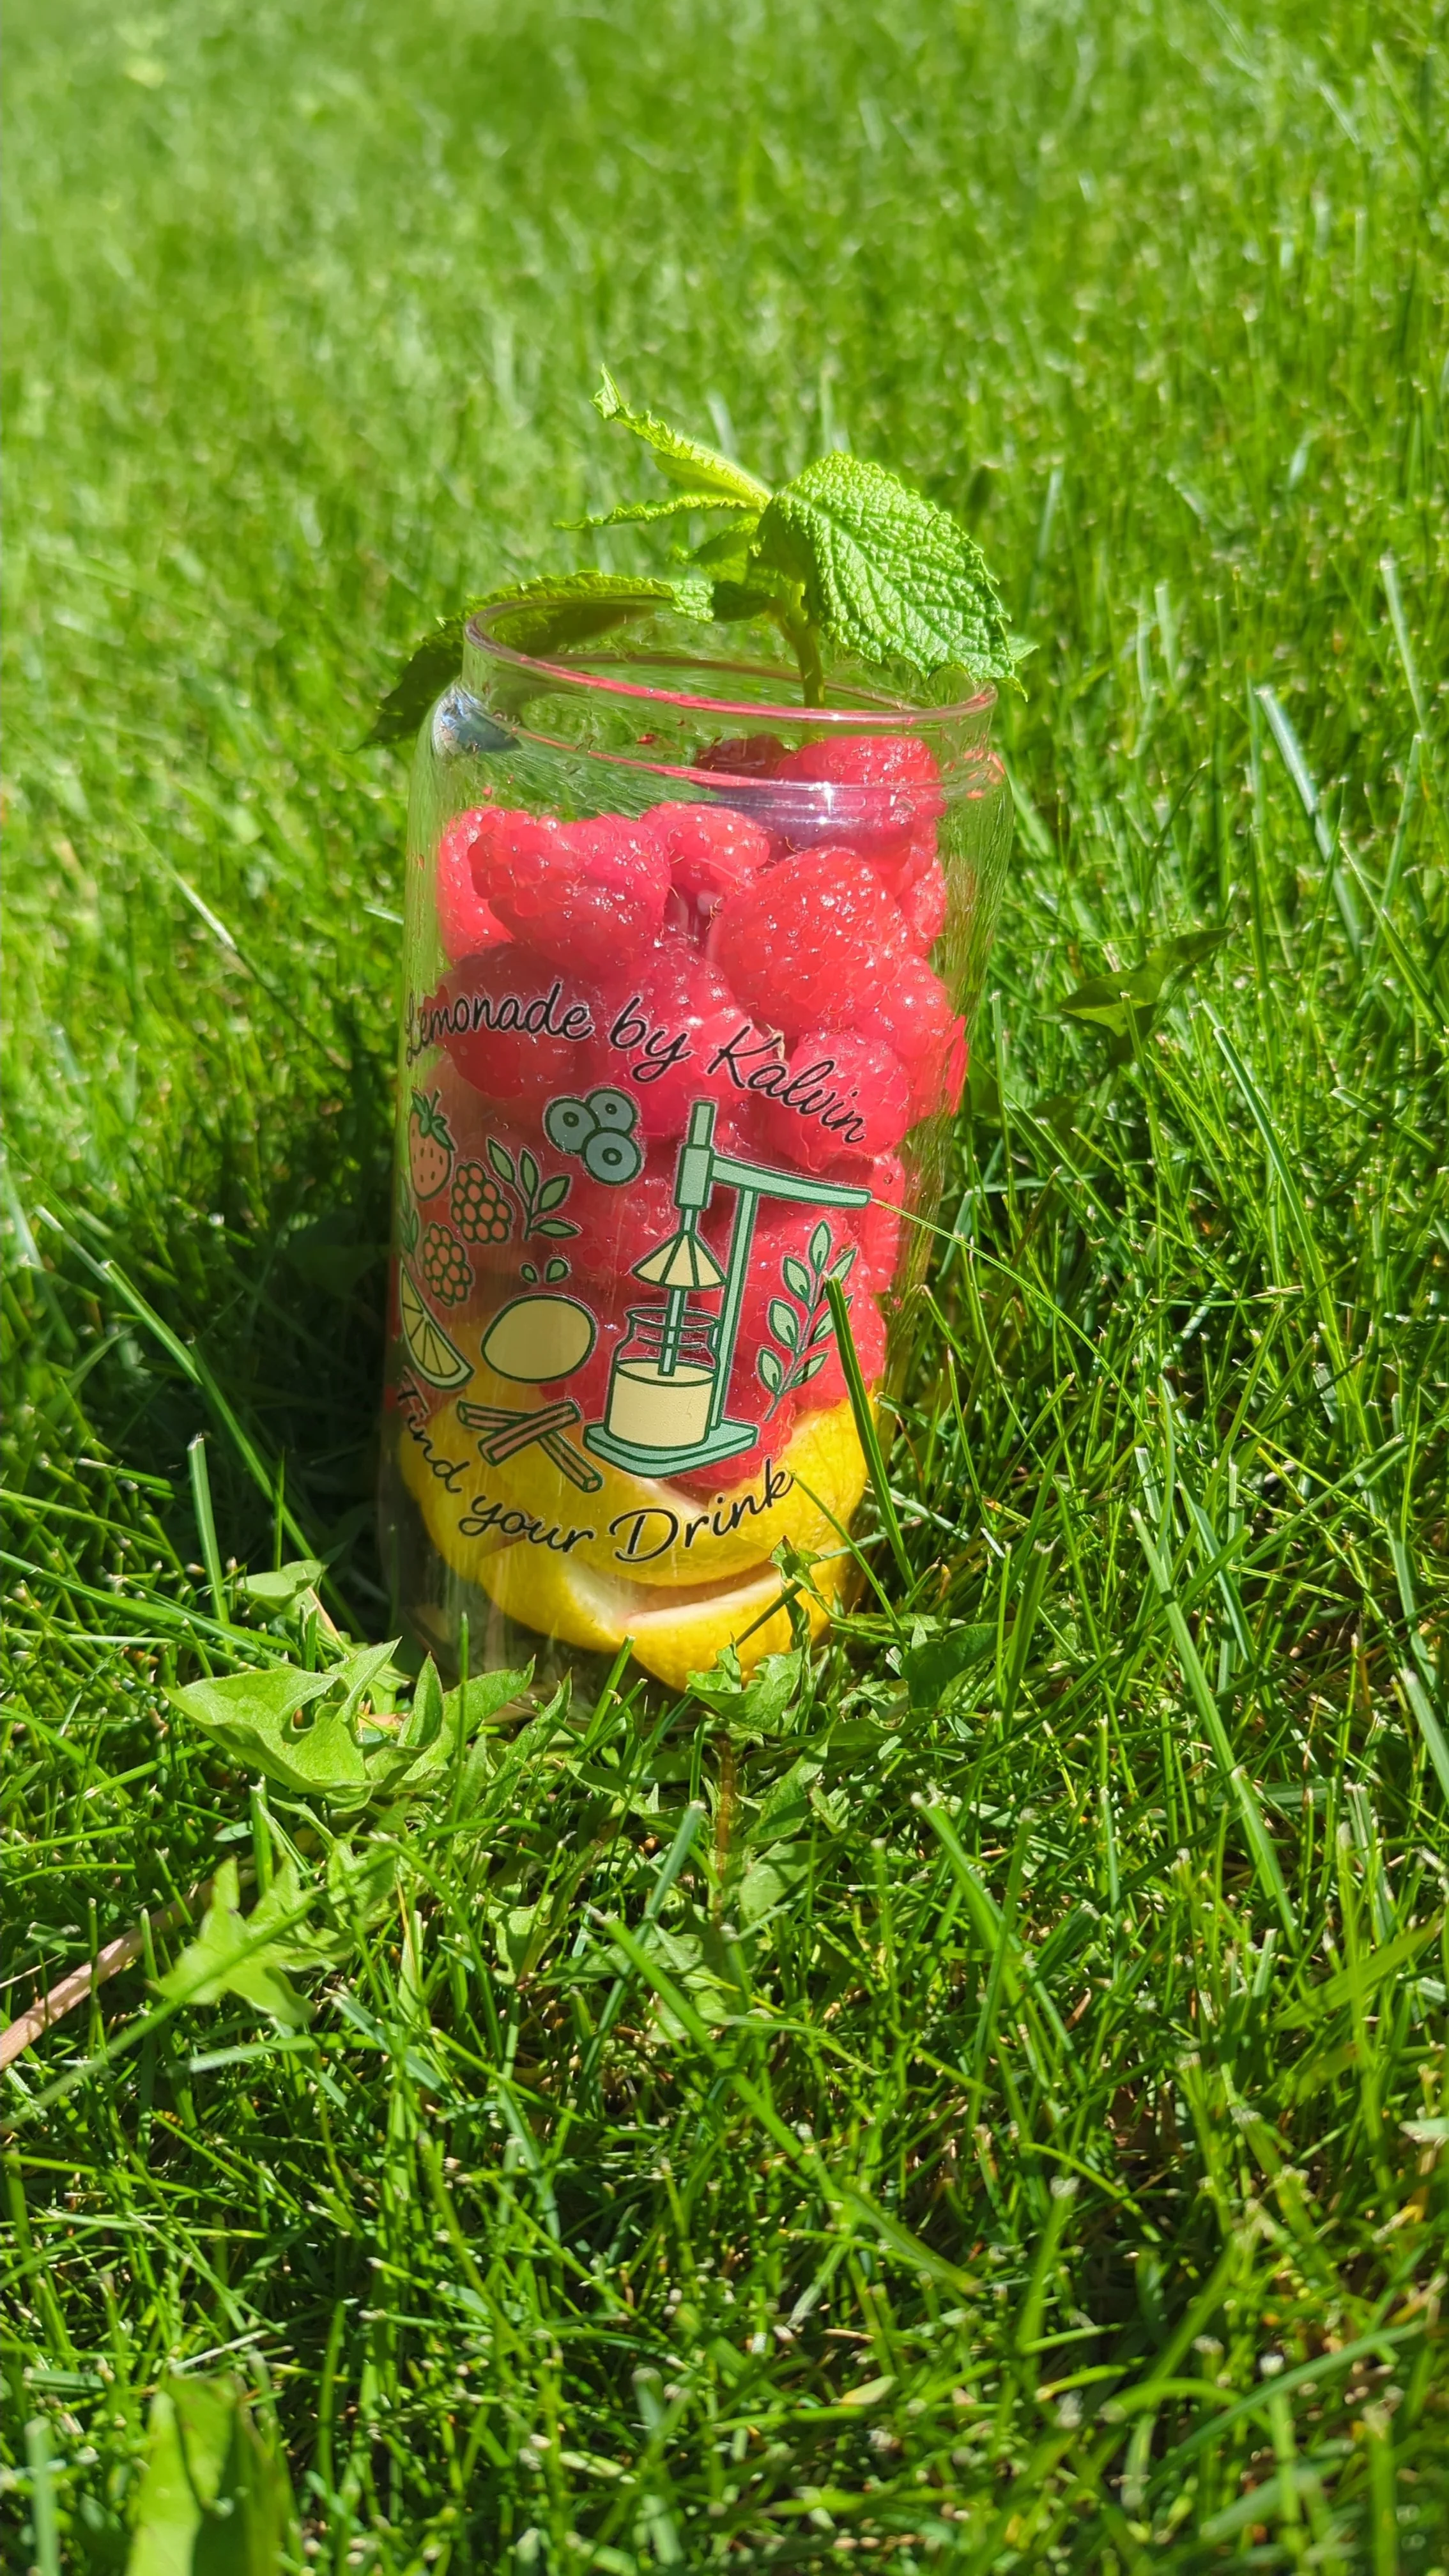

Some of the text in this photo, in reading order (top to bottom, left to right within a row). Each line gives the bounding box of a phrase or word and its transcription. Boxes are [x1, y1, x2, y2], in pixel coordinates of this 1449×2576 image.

[406, 982, 866, 1144] Lemonade by Kalvin
[397, 1369, 795, 1563] Find your Drink
